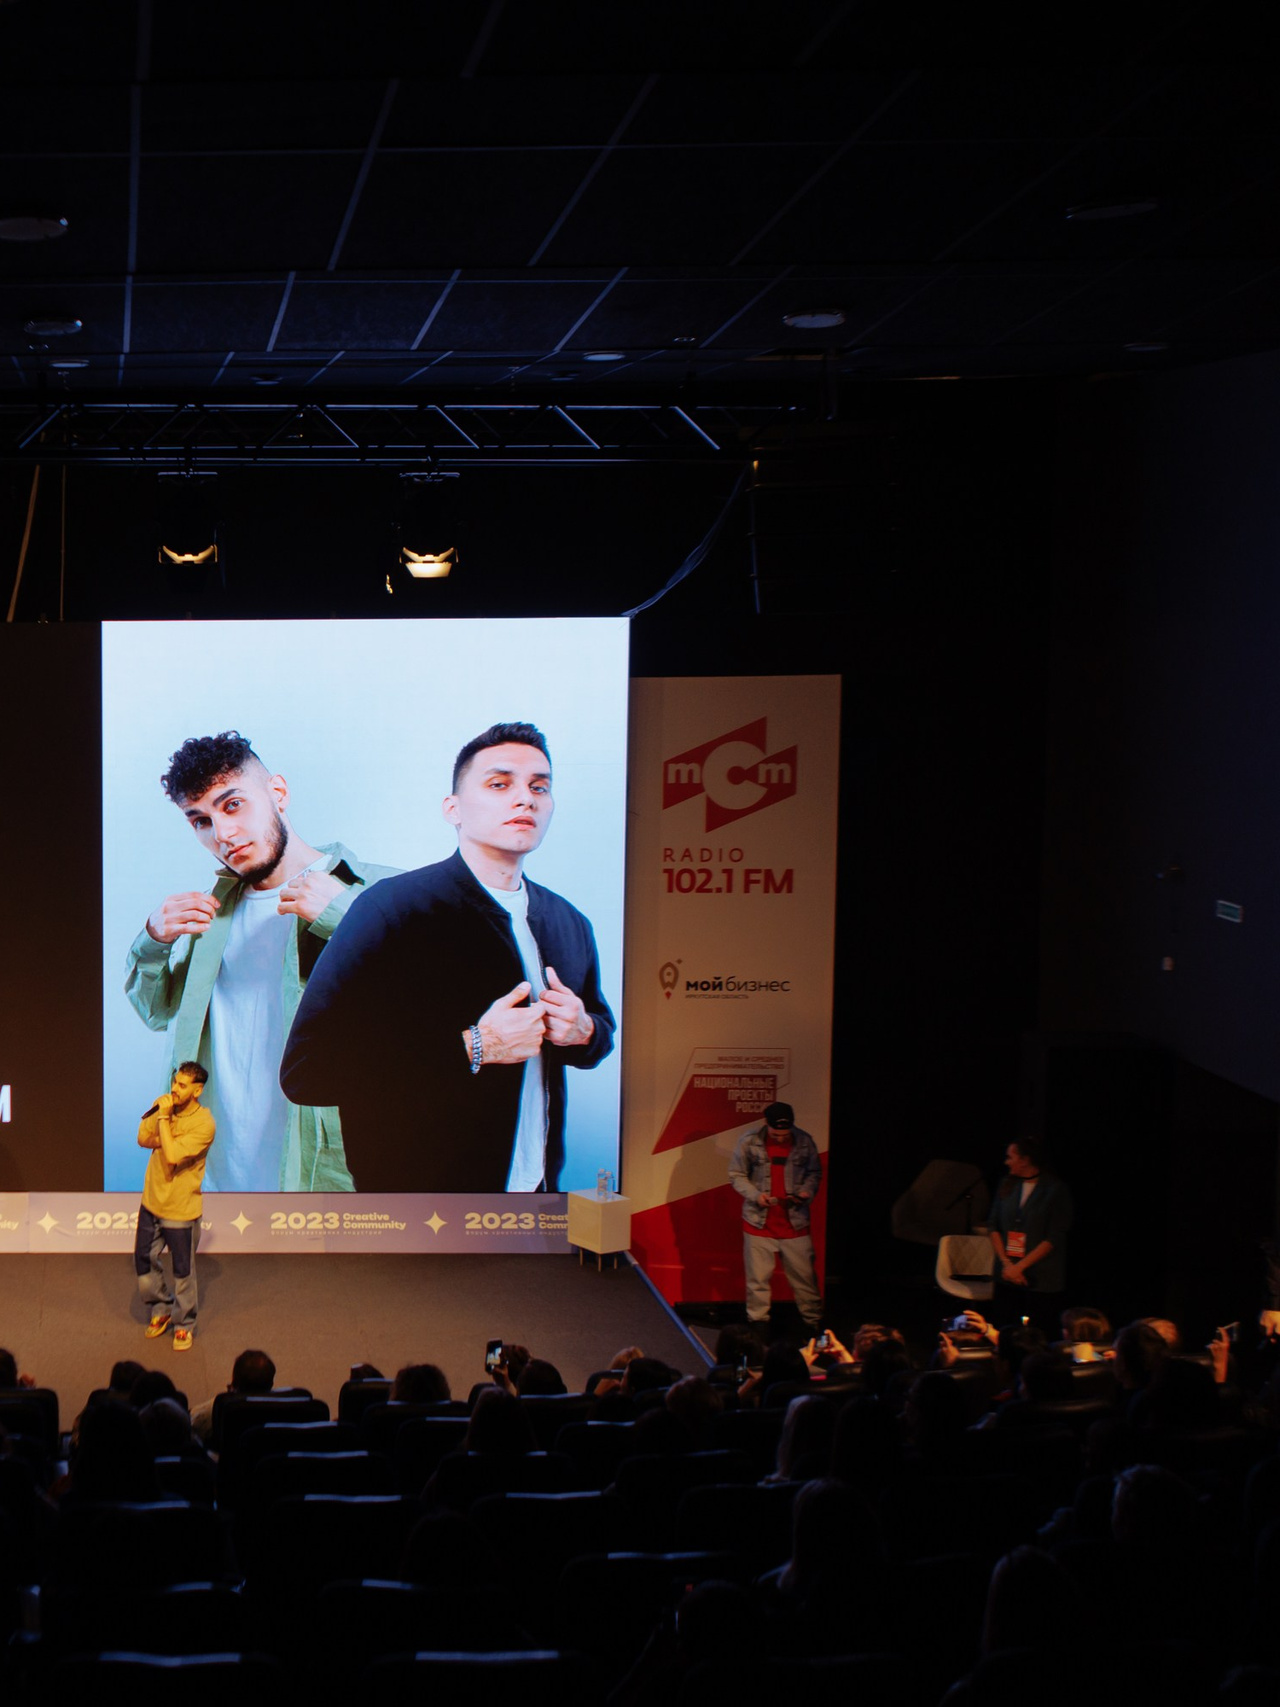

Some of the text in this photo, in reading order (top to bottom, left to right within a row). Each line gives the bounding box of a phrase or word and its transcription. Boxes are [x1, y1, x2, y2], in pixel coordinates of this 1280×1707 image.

[663, 848, 744, 863] RADIO
[662, 868, 794, 893] 102.1 FM
[694, 1077, 774, 1089] НАЦИОНАЛЬНЫЕ
[728, 1089, 774, 1101] ПРОЕКТЫ
[736, 1101, 771, 1113] РОССИ
[270, 1212, 340, 1230] 2023
[343, 1212, 390, 1221] Creative
[464, 1212, 536, 1230] 2023
[538, 1213, 569, 1222] Creat
[343, 1220, 406, 1231] Community
